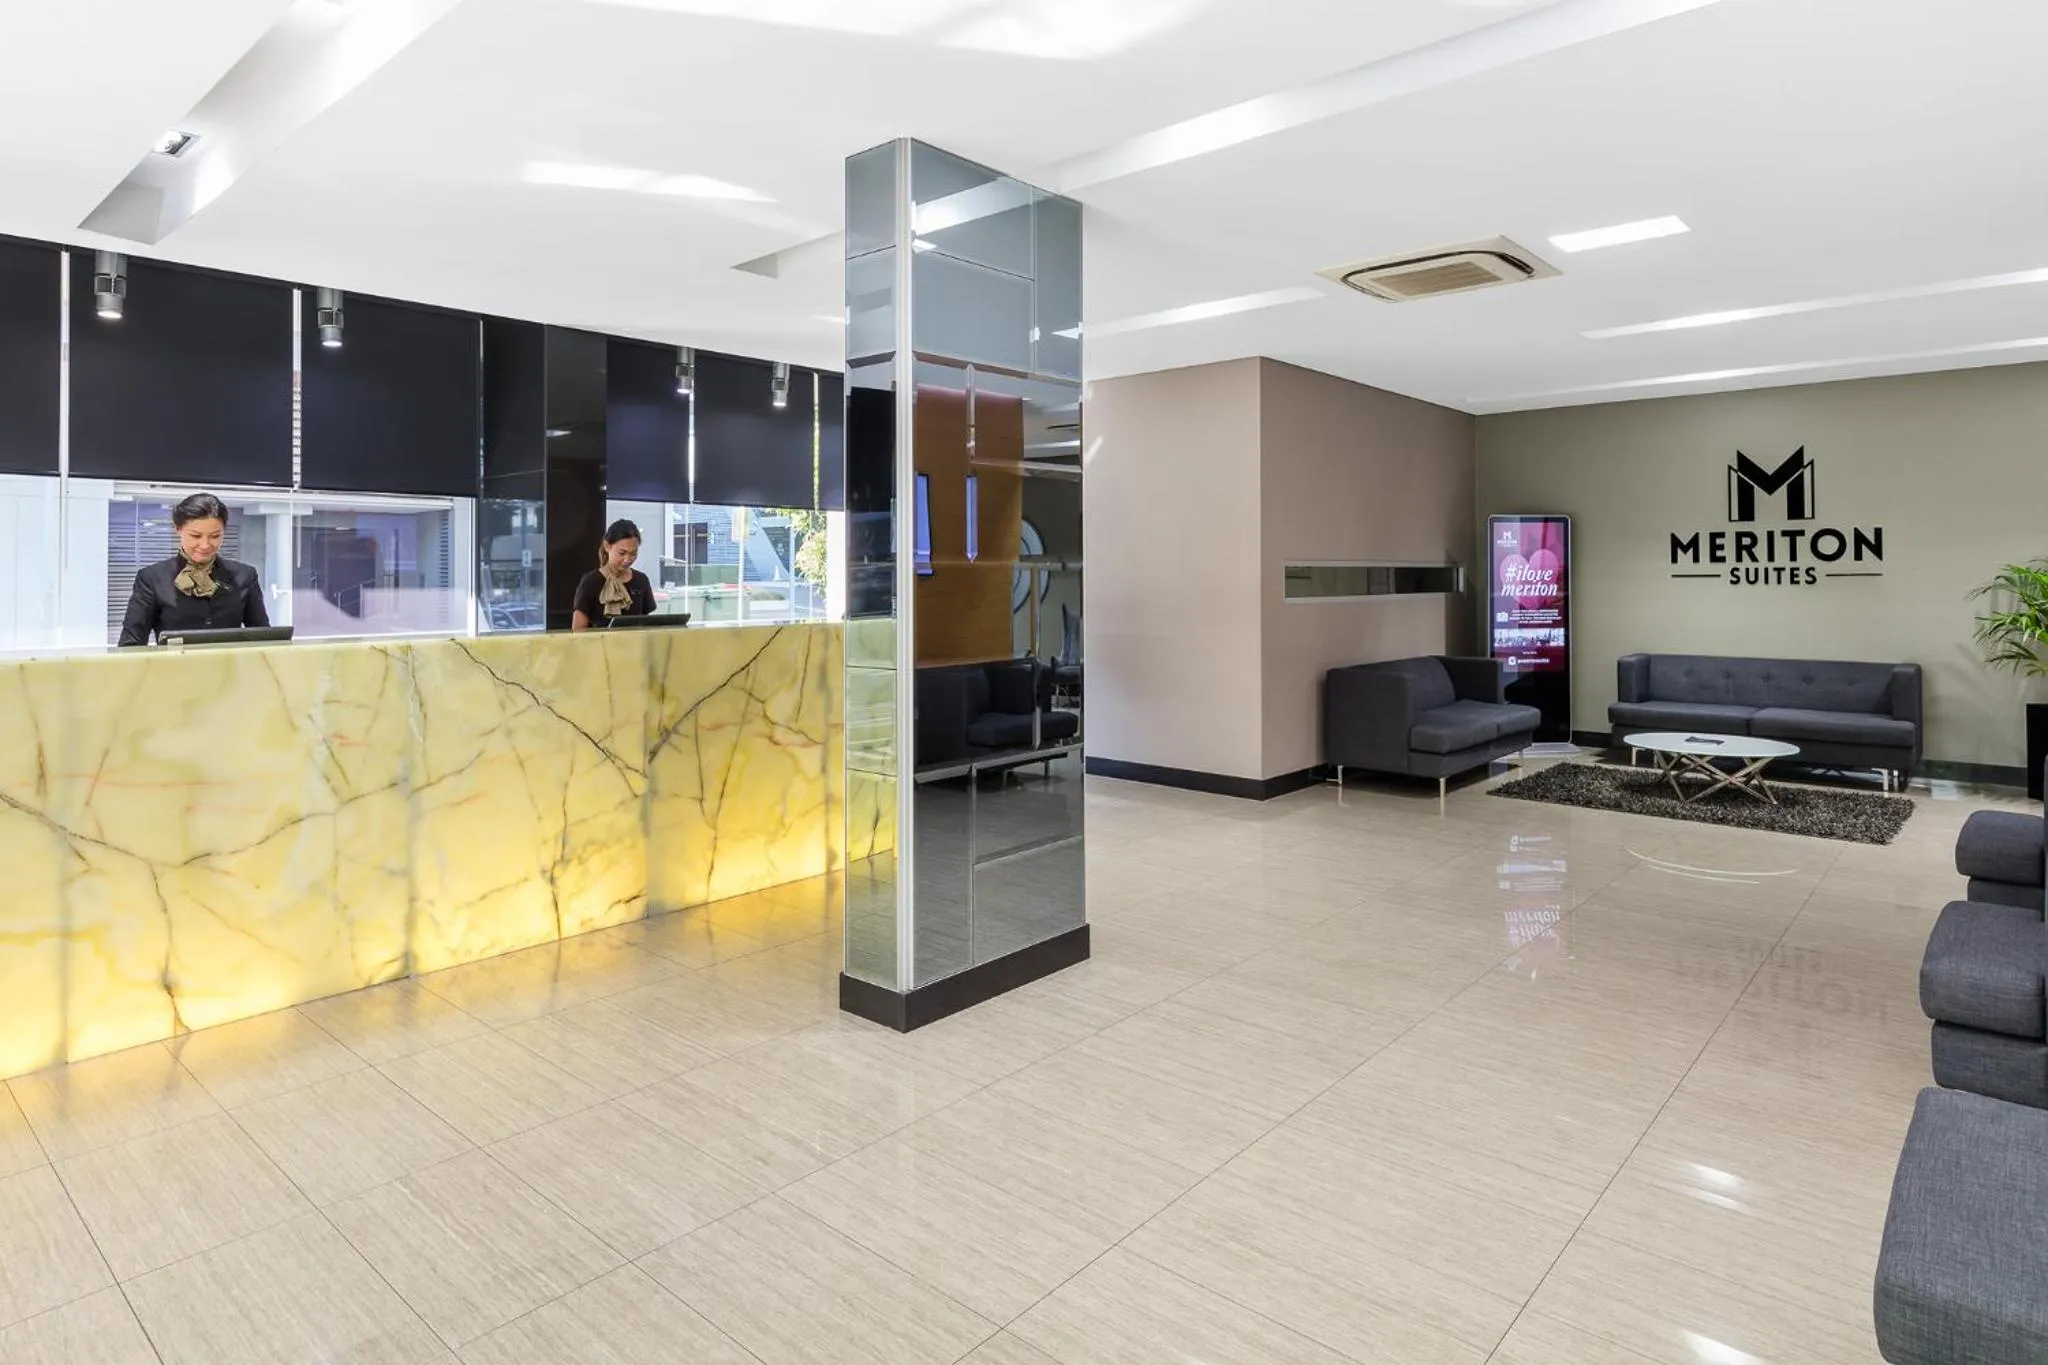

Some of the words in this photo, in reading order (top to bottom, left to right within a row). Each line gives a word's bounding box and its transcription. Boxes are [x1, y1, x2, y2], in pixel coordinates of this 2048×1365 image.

[1670, 527, 1883, 564] MERITON
[1505, 563, 1553, 582] #ilove
[1729, 566, 1818, 585] SUITES
[1501, 582, 1558, 596] meriton
